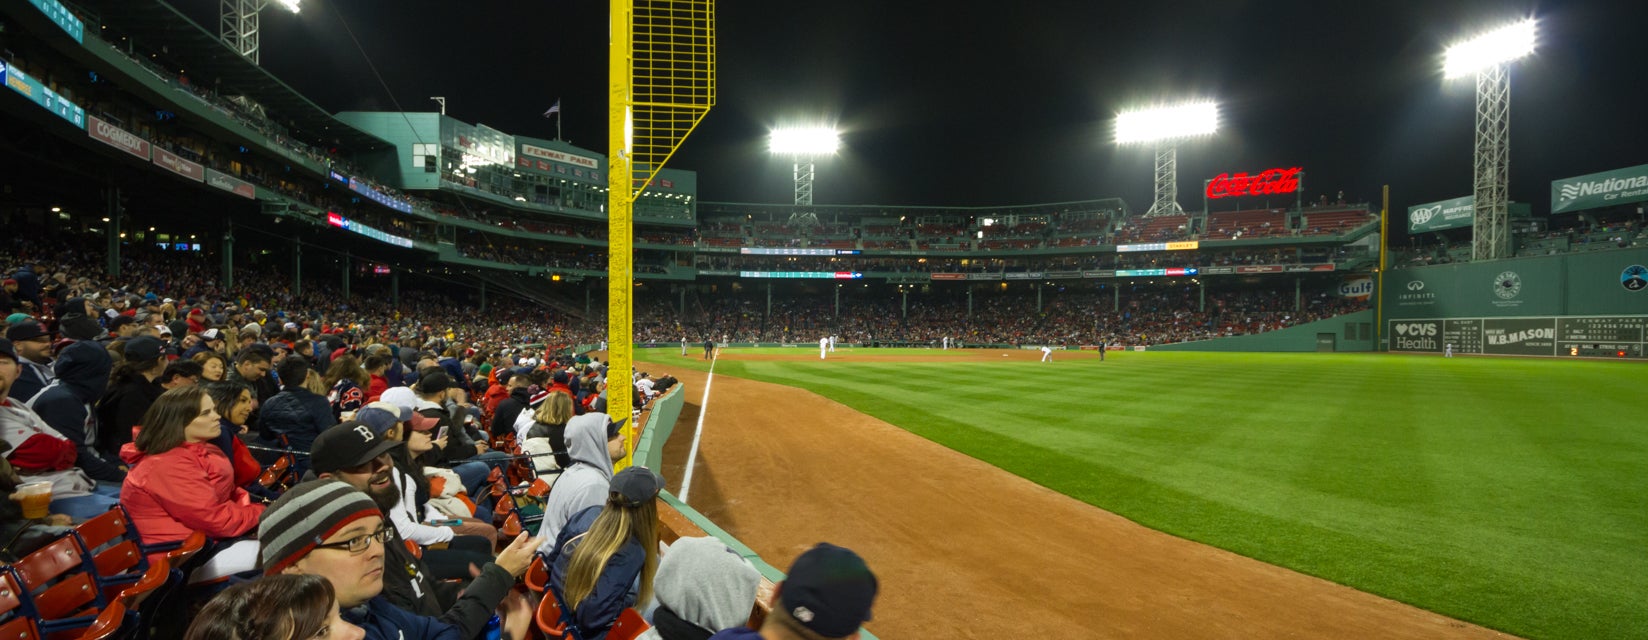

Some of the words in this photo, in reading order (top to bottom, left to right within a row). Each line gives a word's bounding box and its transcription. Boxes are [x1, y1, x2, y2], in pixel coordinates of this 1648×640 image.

[97, 121, 142, 152] COGMEDIX
[527, 147, 566, 160] FENWAY
[570, 156, 593, 167] PARK
[1207, 167, 1302, 198] Coca-Cola
[1603, 192, 1619, 201] Car
[1340, 281, 1372, 295] Gulf
[1408, 322, 1437, 336] CVS
[1396, 336, 1437, 349] Health
[1570, 348, 1578, 356] 2
[353, 425, 374, 442] B
